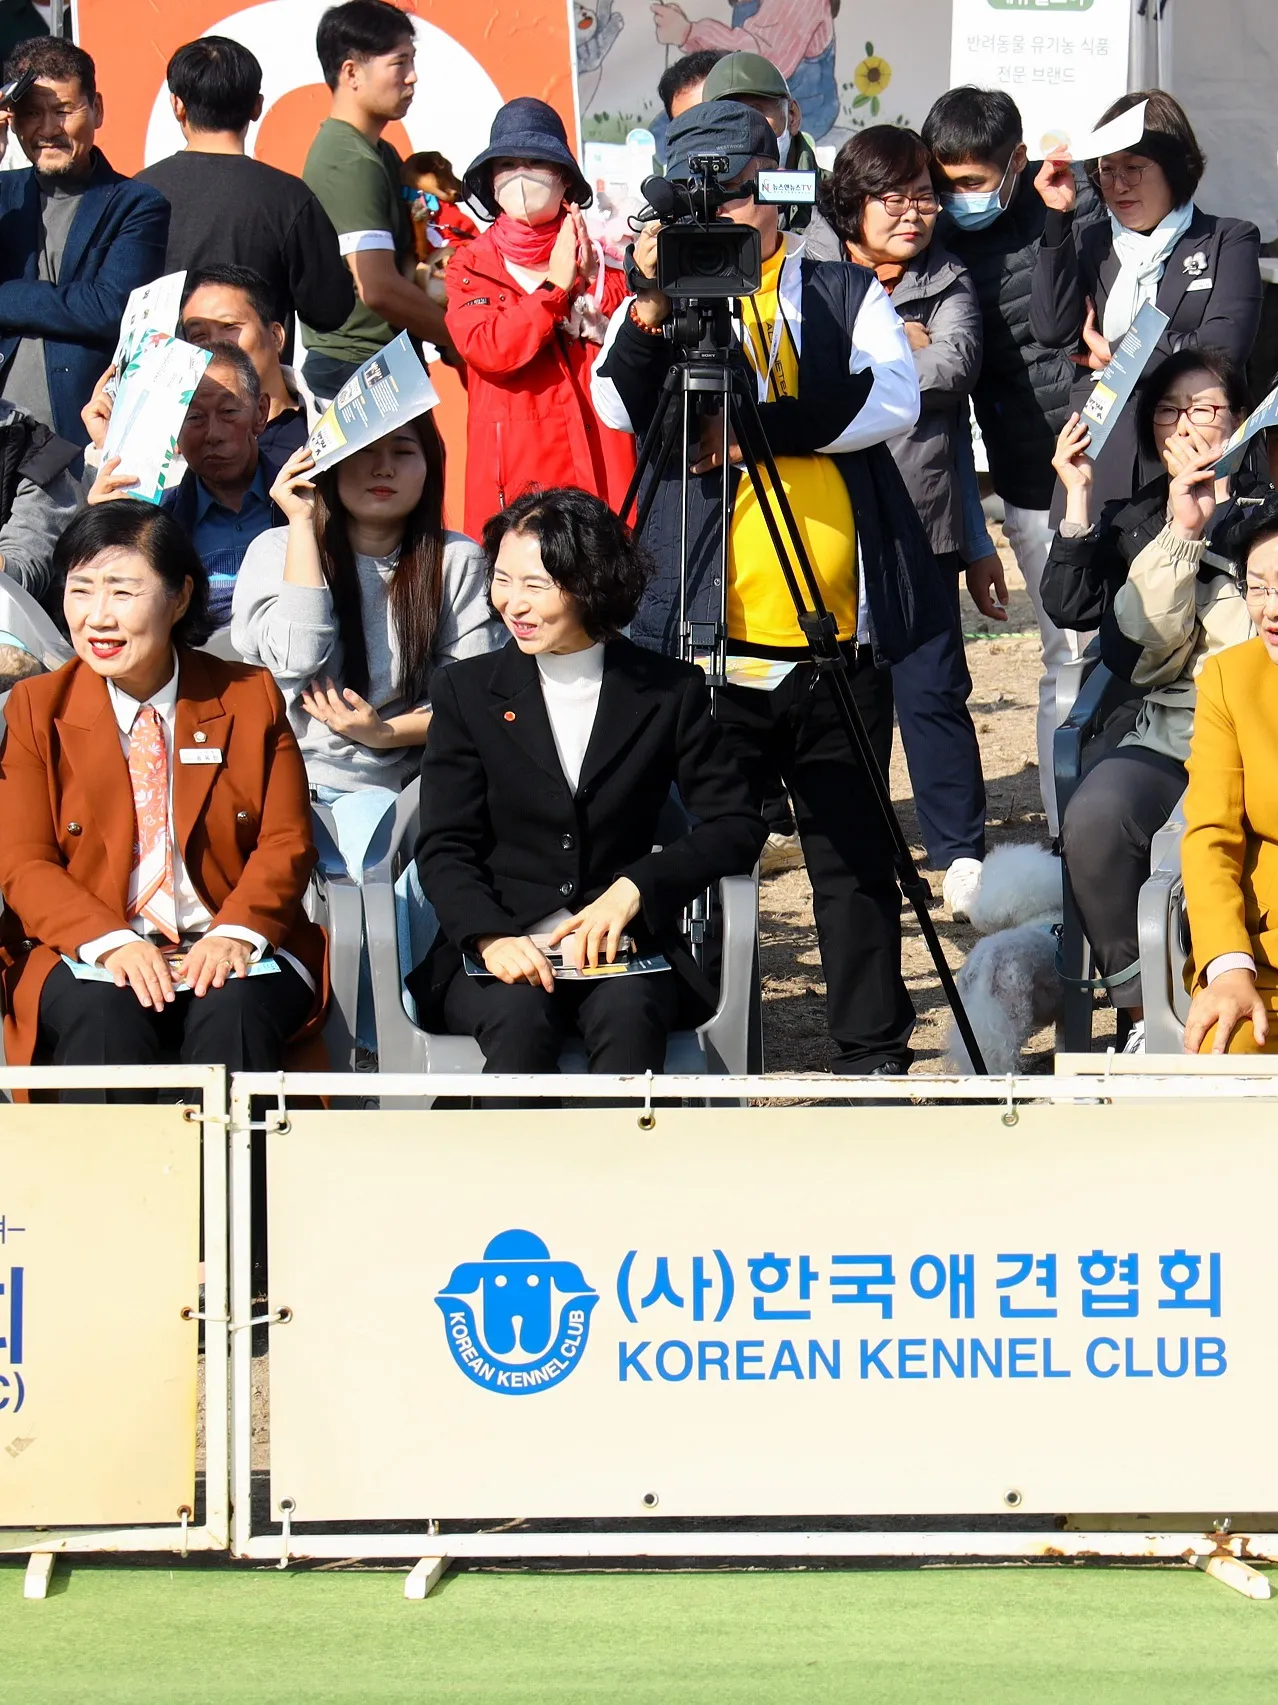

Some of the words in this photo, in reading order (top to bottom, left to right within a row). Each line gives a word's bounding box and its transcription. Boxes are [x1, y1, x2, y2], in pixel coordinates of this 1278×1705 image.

[966, 34, 1026, 55] 반려동물
[1030, 36, 1076, 55] 유기농
[1080, 37, 1111, 56] 식품
[997, 65, 1026, 84] 전문
[1031, 66, 1076, 85] 브랜드
[617, 1249, 1222, 1323] (사)한국애견협회
[449, 1311, 496, 1381] KOREAN
[496, 1357, 570, 1388] KENNEL
[560, 1309, 585, 1358] CLUB
[619, 1340, 841, 1382] KOREAN
[860, 1338, 1072, 1380] KENNEL
[1086, 1337, 1227, 1378] CLUB
